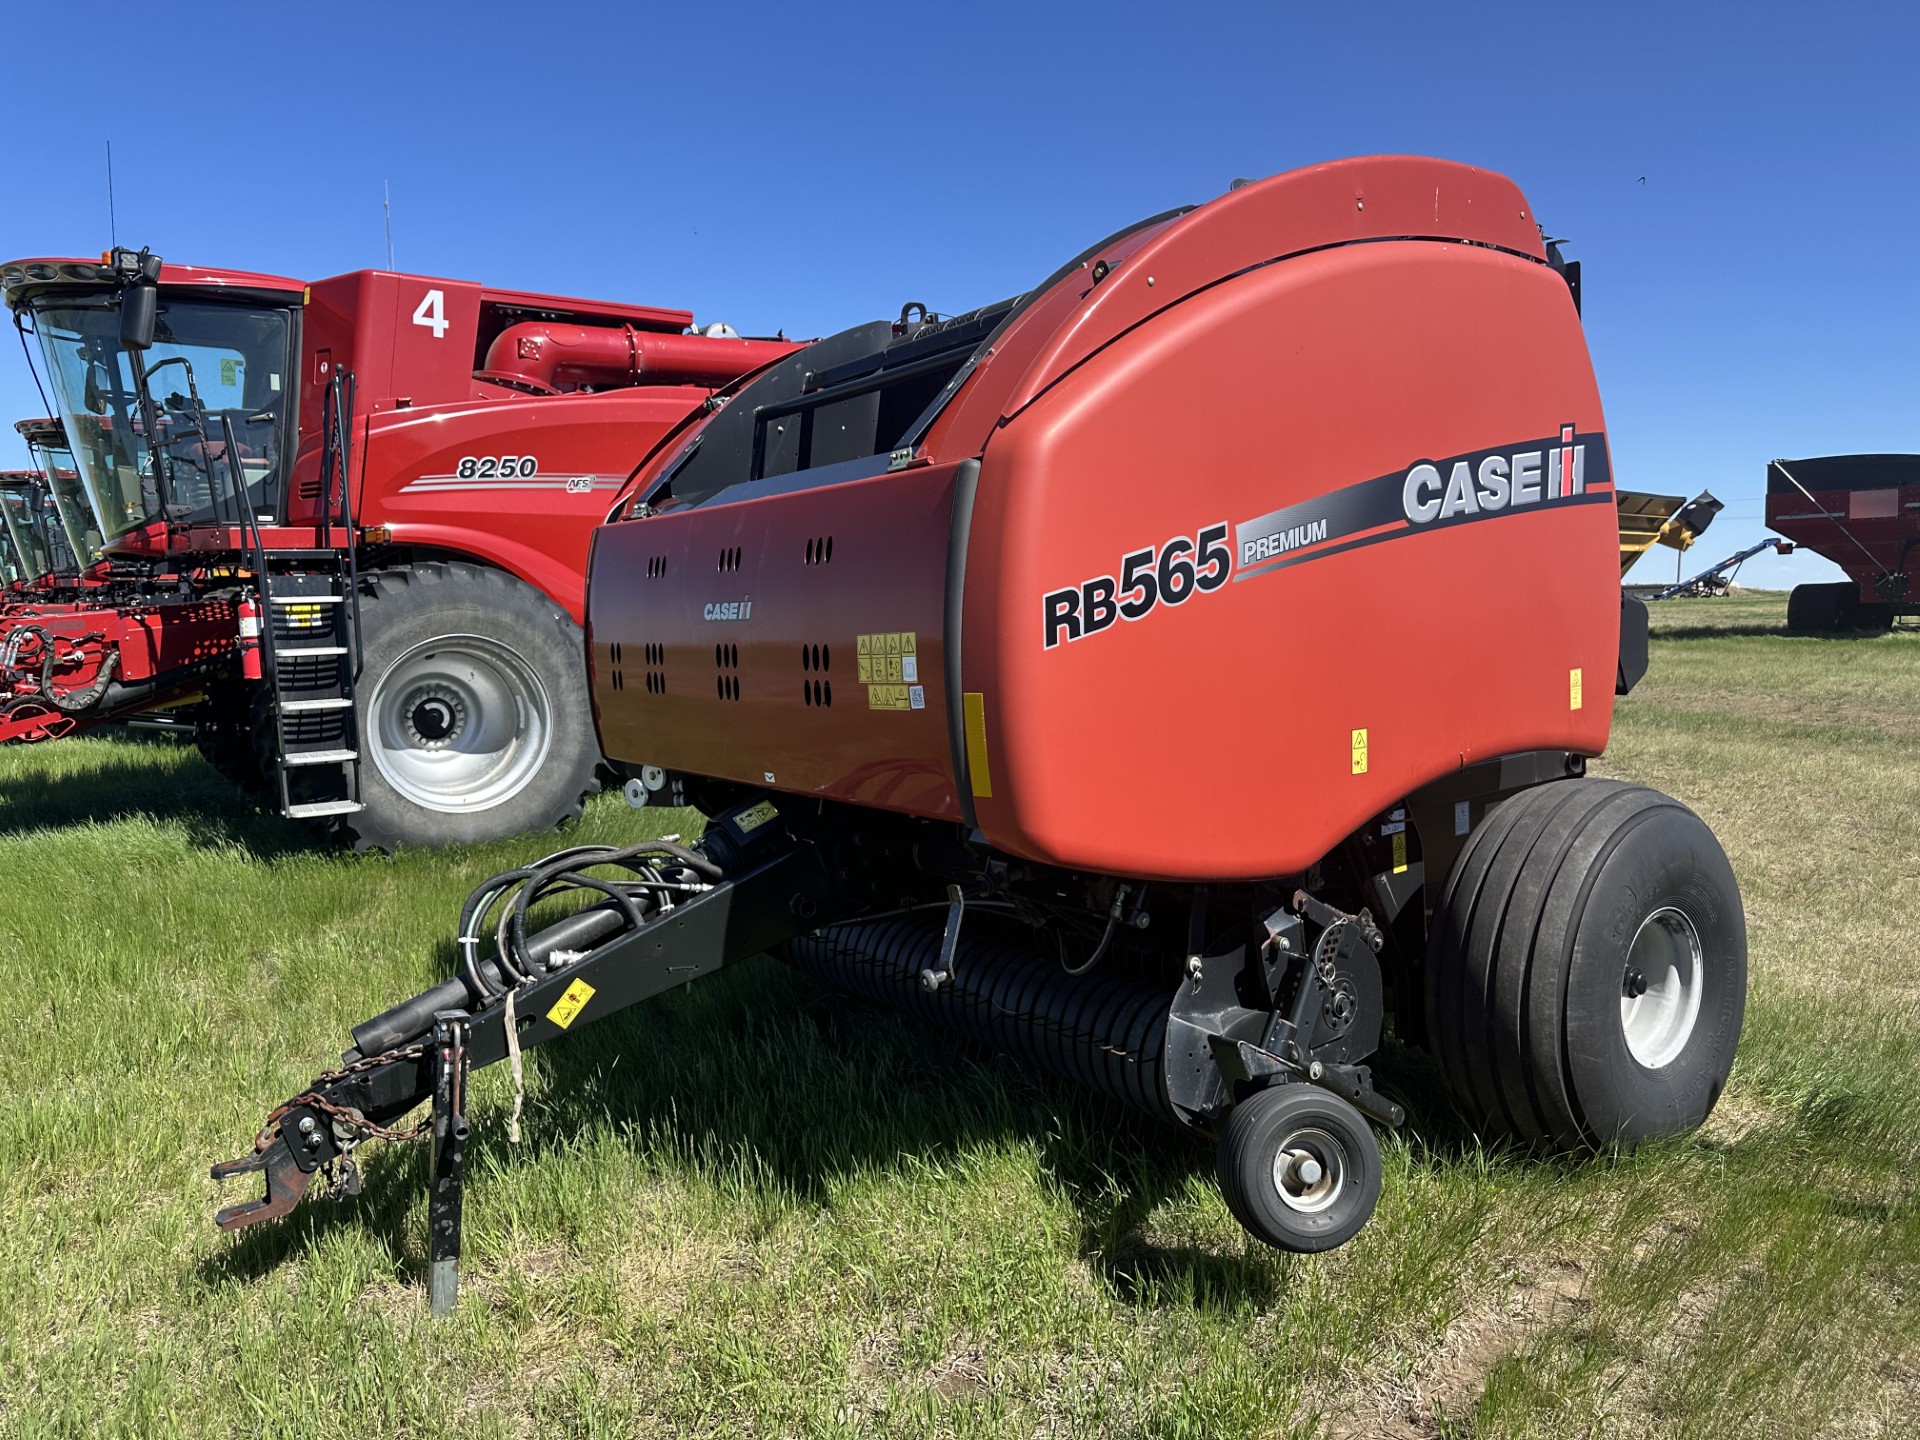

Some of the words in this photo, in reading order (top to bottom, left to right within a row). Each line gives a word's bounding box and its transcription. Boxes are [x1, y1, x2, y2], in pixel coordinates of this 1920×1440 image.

[413, 289, 449, 338] 4
[457, 455, 538, 480] 8250
[567, 478, 589, 490] AFS
[1402, 451, 1543, 524] CASE
[1243, 518, 1328, 565] PREMIUM
[1042, 520, 1232, 650] RB565
[703, 602, 739, 621] CASE
